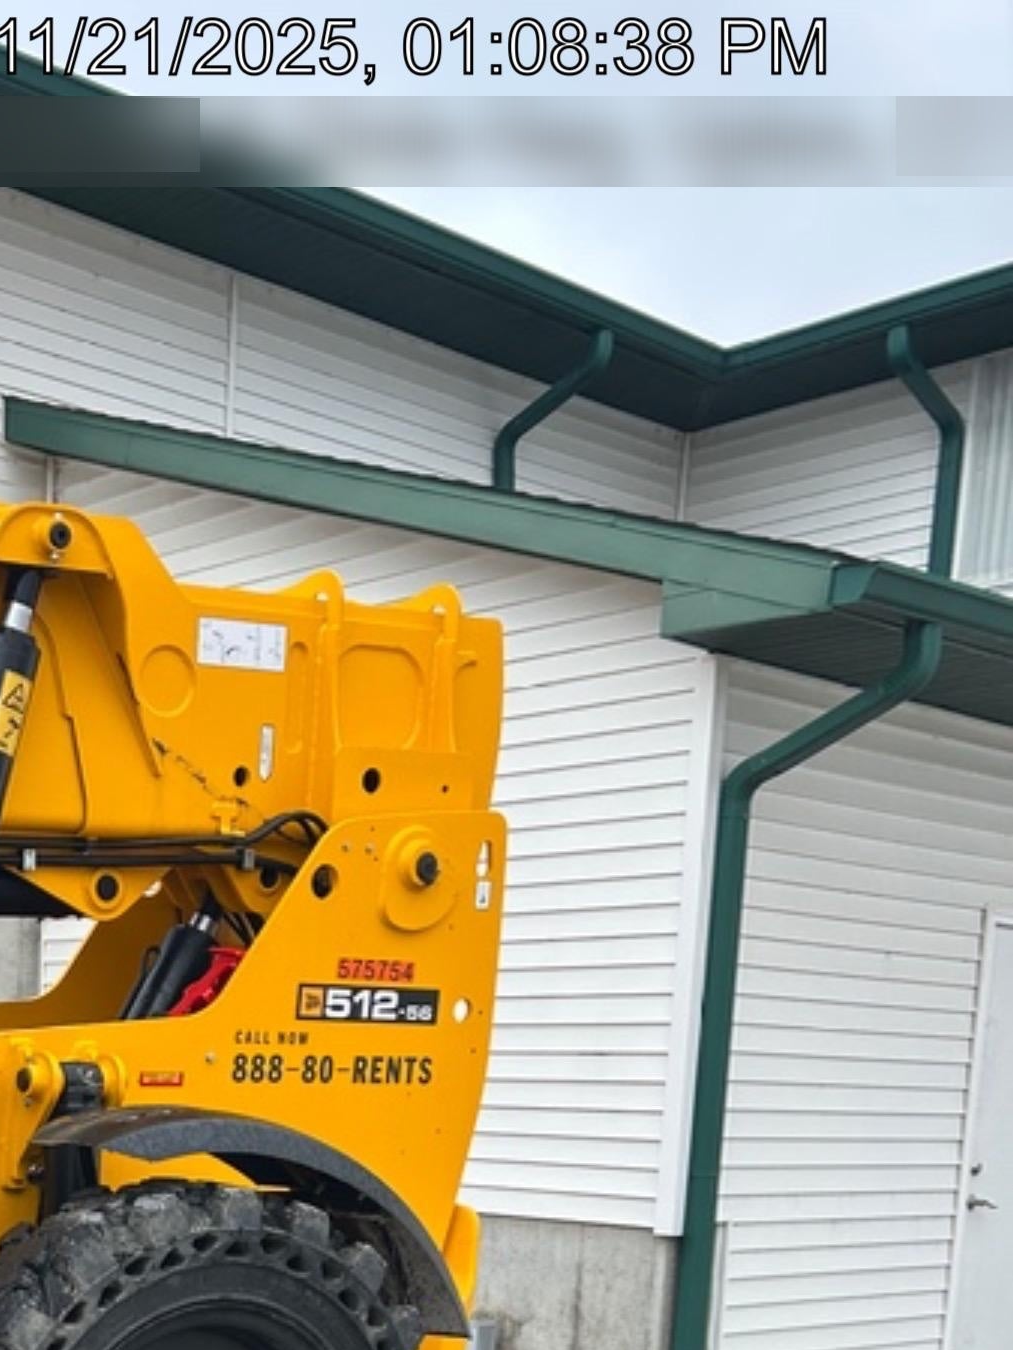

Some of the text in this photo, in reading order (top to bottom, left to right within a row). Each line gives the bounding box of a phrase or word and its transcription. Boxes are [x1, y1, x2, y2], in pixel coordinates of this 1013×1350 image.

[337, 957, 414, 982] 575754
[235, 1031, 309, 1045] CALL NOW
[232, 1054, 433, 1084] 888-80-RENTS
